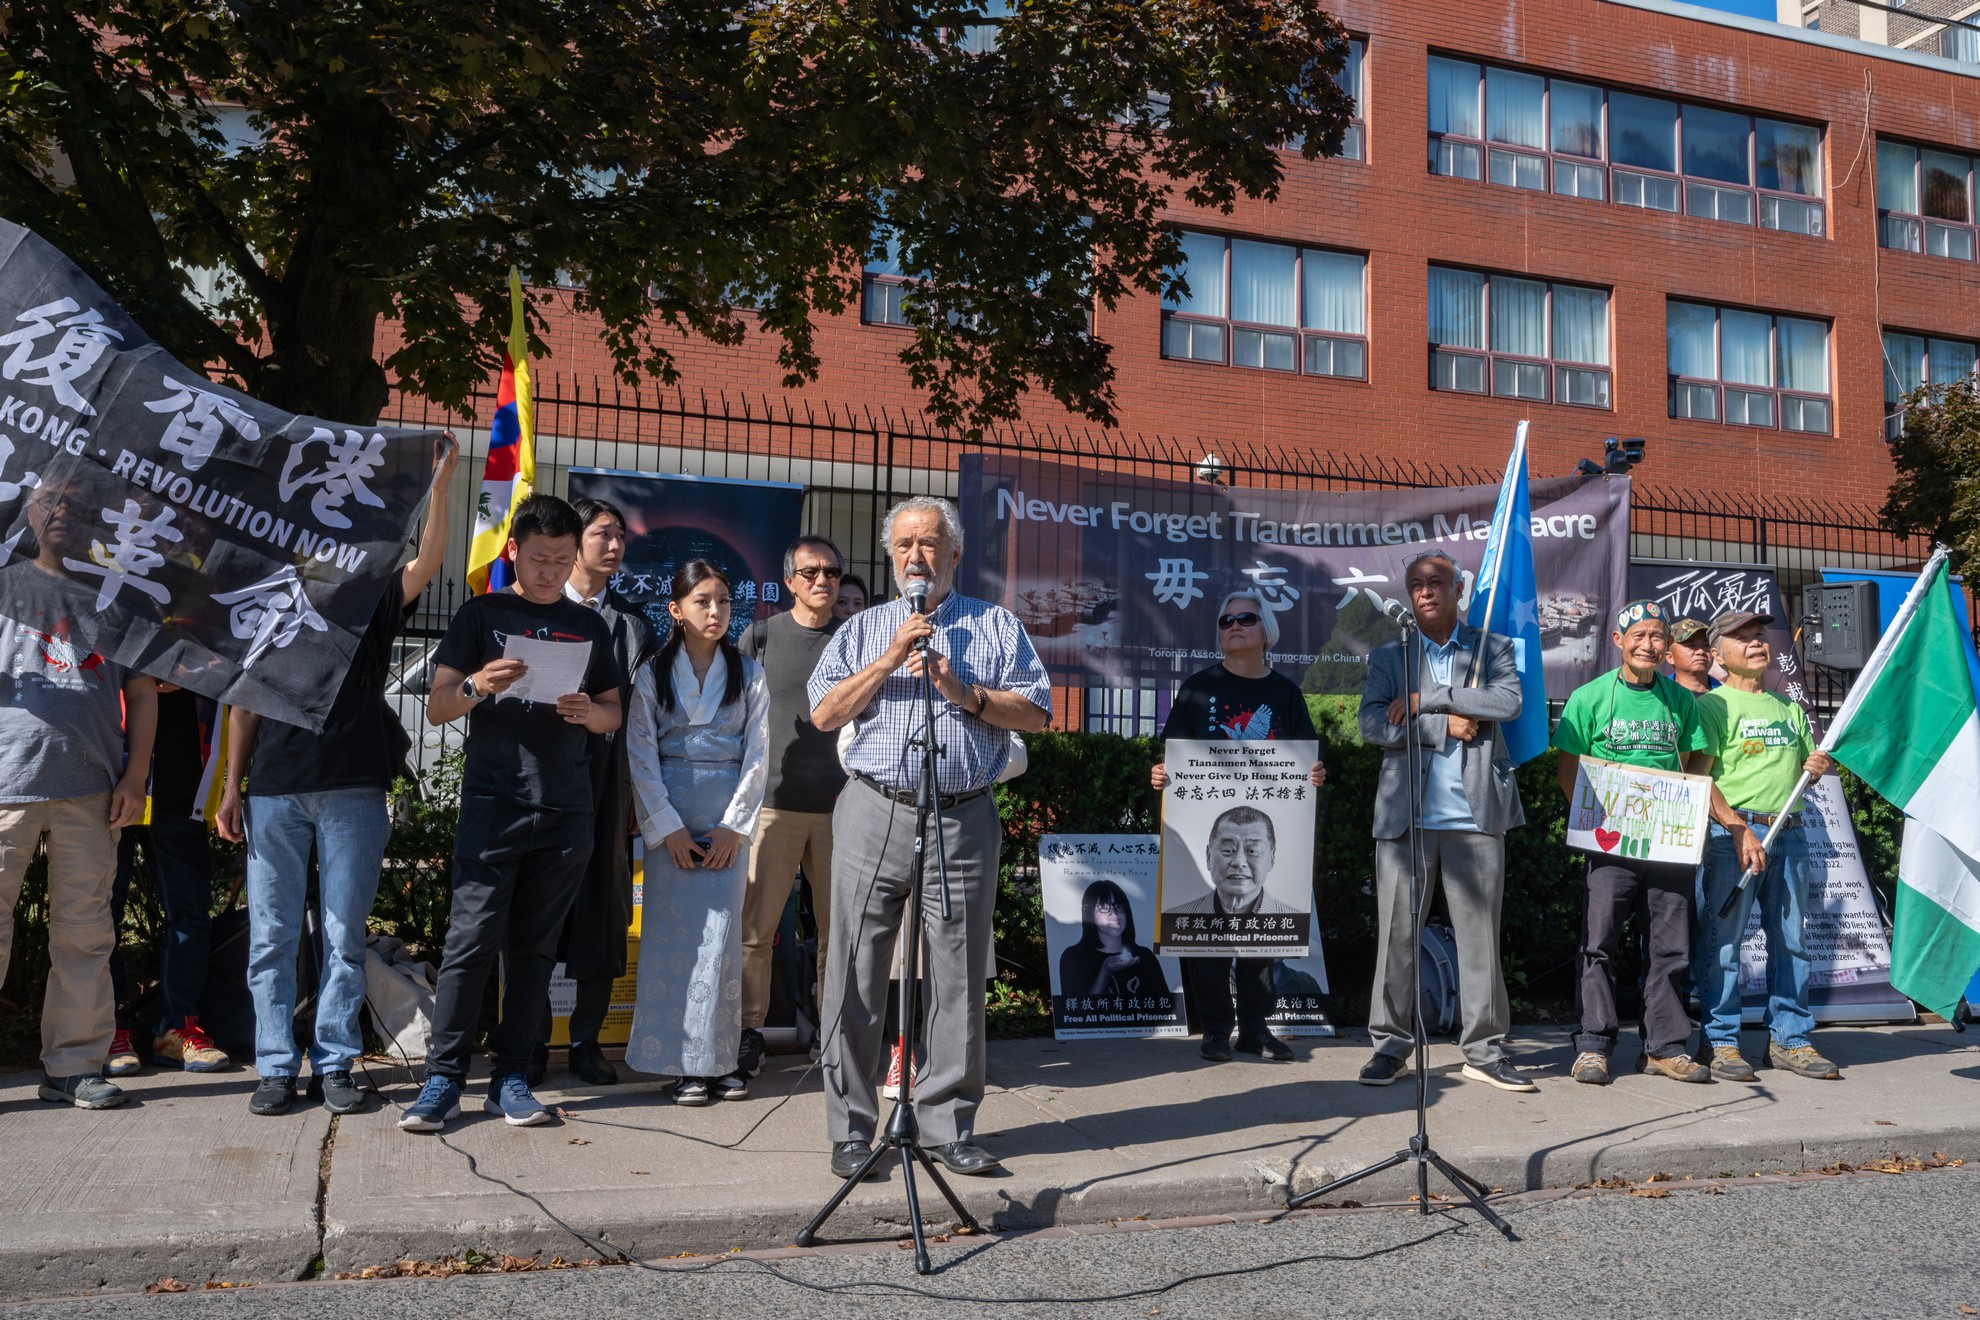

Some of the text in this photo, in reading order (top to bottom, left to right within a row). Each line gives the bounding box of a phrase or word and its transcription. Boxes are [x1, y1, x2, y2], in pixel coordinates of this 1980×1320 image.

[0, 395, 367, 574] KONG REVOLUTION NOW
[997, 488, 1597, 546] Never Forget Tiananmen Maacre
[728, 579, 780, 603] 維園
[1149, 648, 1188, 658] Toronto
[1190, 649, 1225, 659] Associ
[1265, 651, 1319, 664] Democracy
[1321, 652, 1330, 662] in
[1333, 653, 1360, 663] China
[1740, 718, 1768, 728] Team
[1741, 727, 1781, 738] Taiwan
[1209, 747, 1276, 756] Never Forget
[1188, 759, 1295, 767] Tiananmen Massacre
[1175, 772, 1308, 781] Never Give Up Hong Kong
[1652, 780, 1690, 803] CHINA
[1582, 786, 1619, 815] UN
[1624, 795, 1652, 821] FOR
[1607, 815, 1656, 838] TAIWAN
[1823, 840, 1842, 850] hung
[1843, 841, 1856, 849] two
[1816, 850, 1828, 858] the
[1823, 860, 1843, 869] 2022.
[1107, 867, 1126, 876] Hong
[1129, 868, 1148, 876] Kong
[1828, 880, 1842, 889] and
[1845, 880, 1864, 889] work,
[1820, 890, 1829, 899] Xi
[1843, 911, 1862, 919] want
[1174, 916, 1296, 931] 釋放所有政治犯
[1840, 921, 1851, 929] NO
[1851, 921, 1866, 930] lies;
[1867, 921, 1879, 929] We
[1172, 933, 1299, 941] Free All Political Prisoners
[1856, 931, 1868, 939] We
[1848, 942, 1860, 950] Not
[1864, 942, 1884, 951] being
[1065, 996, 1172, 1011] 釋放所有政治犯
[1063, 1013, 1177, 1023] Free All Political Prisoners
[1285, 1012, 1324, 1020] Prisoners
